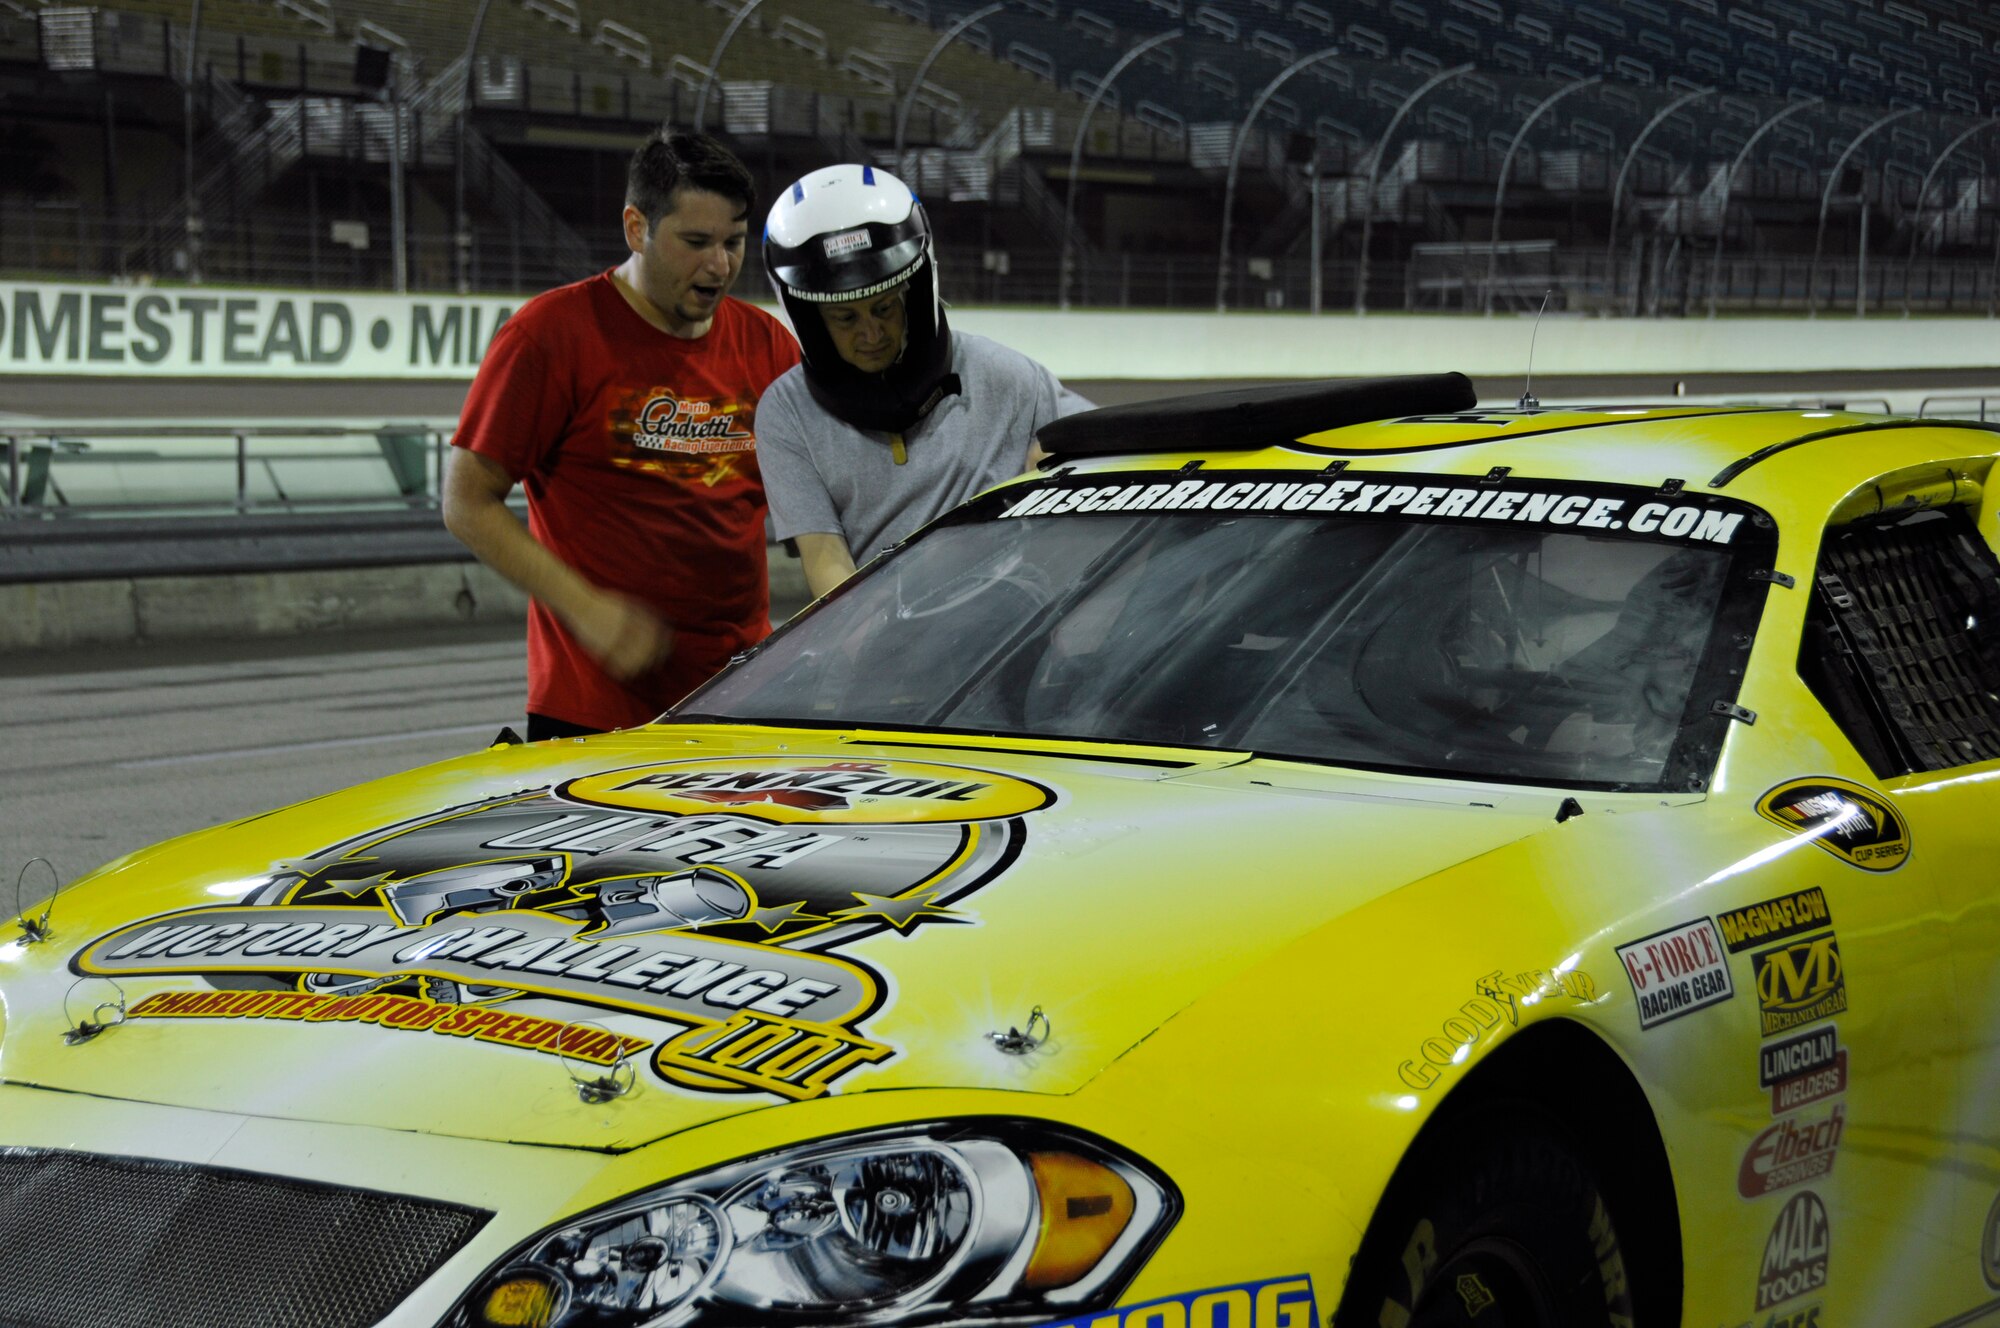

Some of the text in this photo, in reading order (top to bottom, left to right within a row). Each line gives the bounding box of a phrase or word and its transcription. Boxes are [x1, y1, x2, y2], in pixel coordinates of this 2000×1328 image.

[0, 291, 353, 364] MESTEAD
[636, 397, 751, 439] Andretti
[678, 401, 710, 413] Mario
[664, 439, 699, 453] Racing
[998, 479, 1745, 544] NASCARRACINGEXPERIENCE.COM
[607, 770, 993, 801] PENNZOIL
[1855, 843, 1905, 862] CUP SERIES
[1719, 893, 1827, 945] MAGNAFLOW
[104, 921, 843, 1016] VICTORY CHALLENGE
[1625, 924, 1719, 990] G-FORCE
[1640, 967, 1727, 1021] RACING GEAR
[1761, 986, 1847, 1035] MECHANIX WEAR
[128, 991, 652, 1065] CHARLOTTE MOTOR SPEEDWAY
[1397, 970, 1598, 1091] GOODYEAR
[1764, 1033, 1834, 1079] LINCOLN
[1779, 1068, 1840, 1108] WELDERS
[1740, 1105, 1844, 1192] Eibach
[1764, 1154, 1829, 1191] SPRINGS
[1056, 1279, 1312, 1328] OOG
[1759, 1261, 1825, 1307] TOOLS
